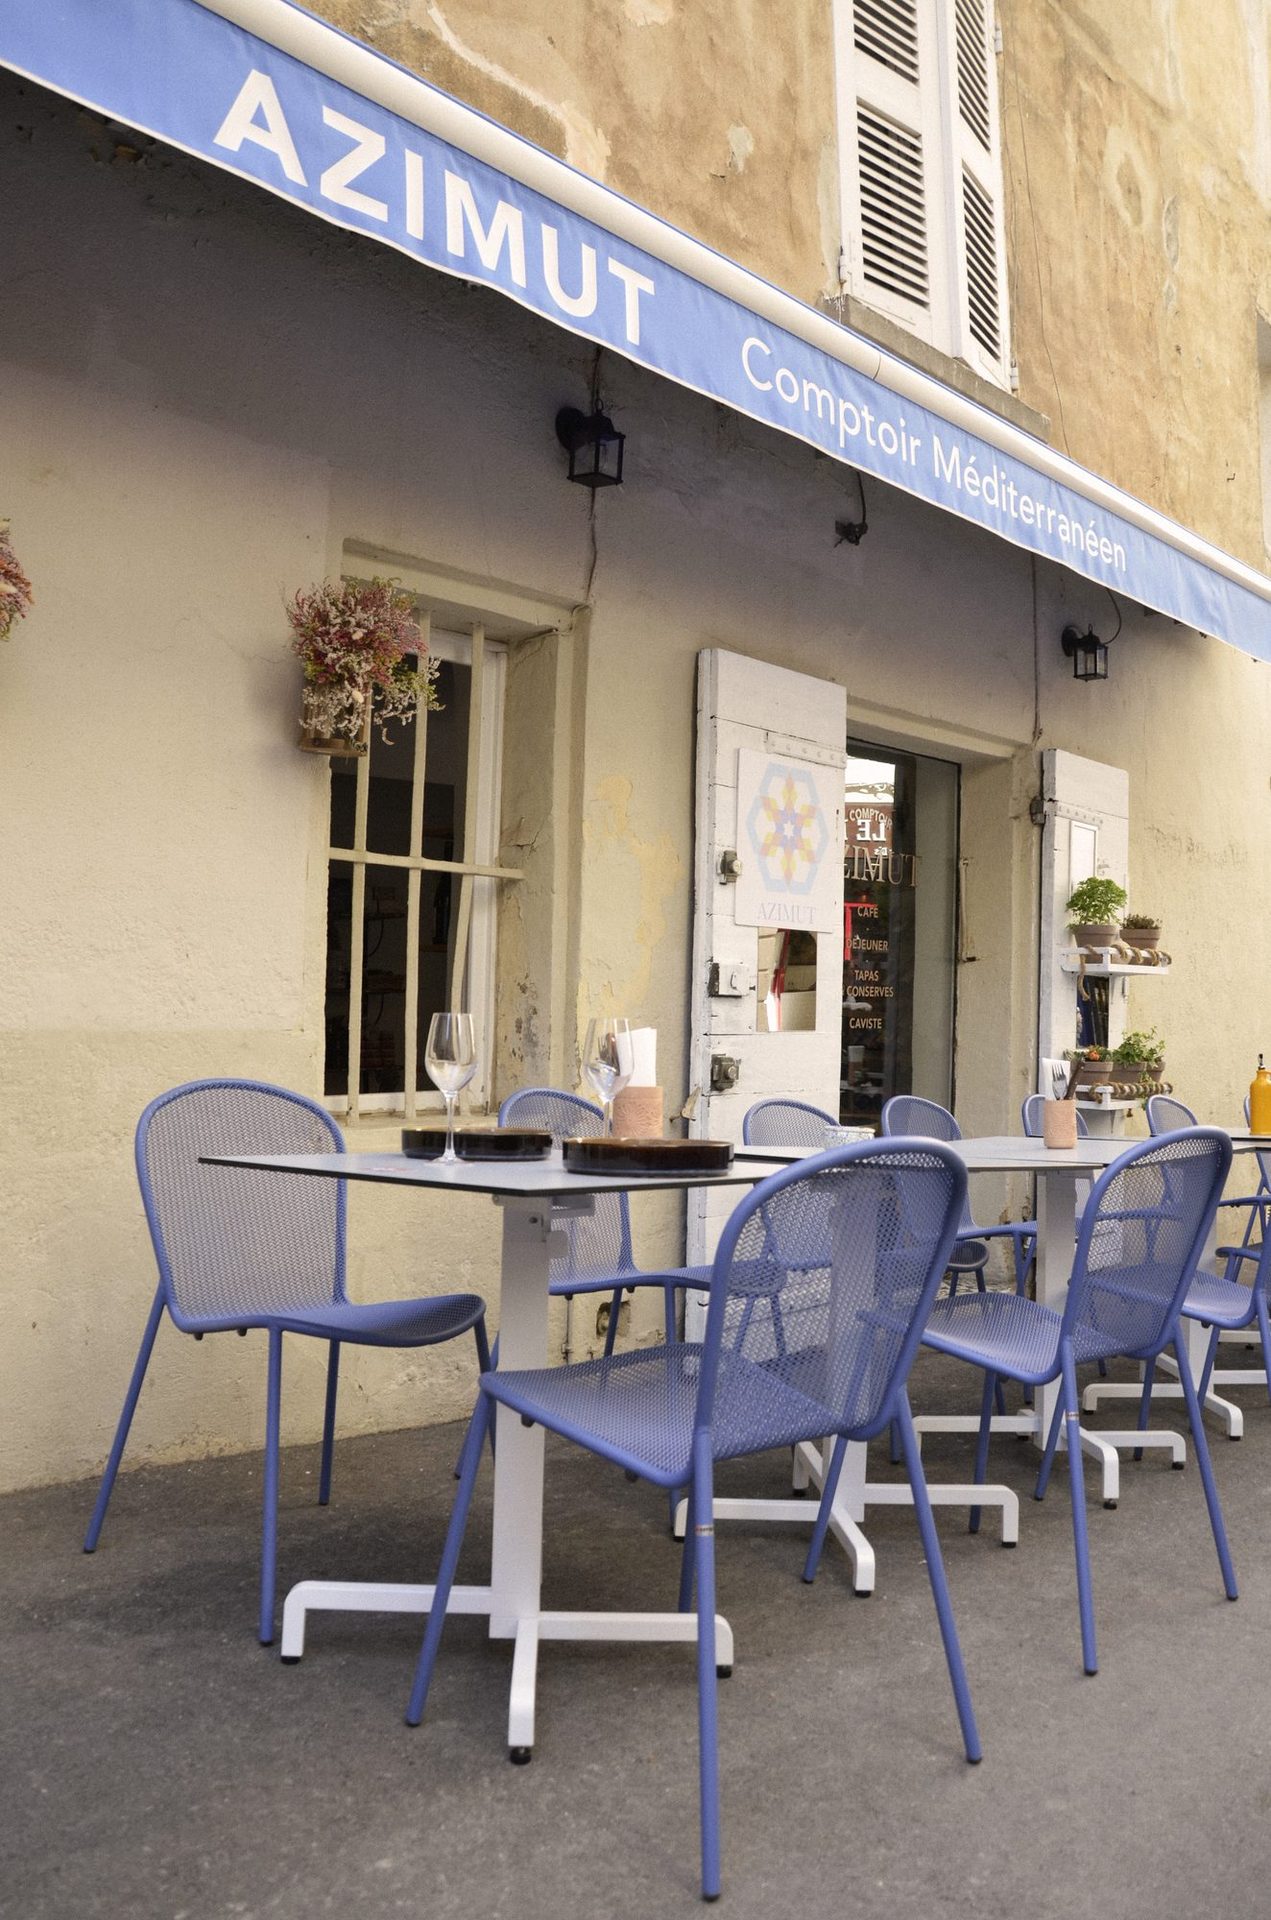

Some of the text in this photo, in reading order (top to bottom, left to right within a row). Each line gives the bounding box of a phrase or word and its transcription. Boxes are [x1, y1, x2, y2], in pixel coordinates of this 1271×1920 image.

[213, 68, 656, 345] AZIMUT
[741, 336, 1127, 572] Comptoir Méditerranéen
[756, 901, 817, 925] AZIMUT
[854, 970, 879, 981] TAPAS
[846, 985, 894, 998] CONSERVES
[849, 1017, 882, 1029] CAVISTE
